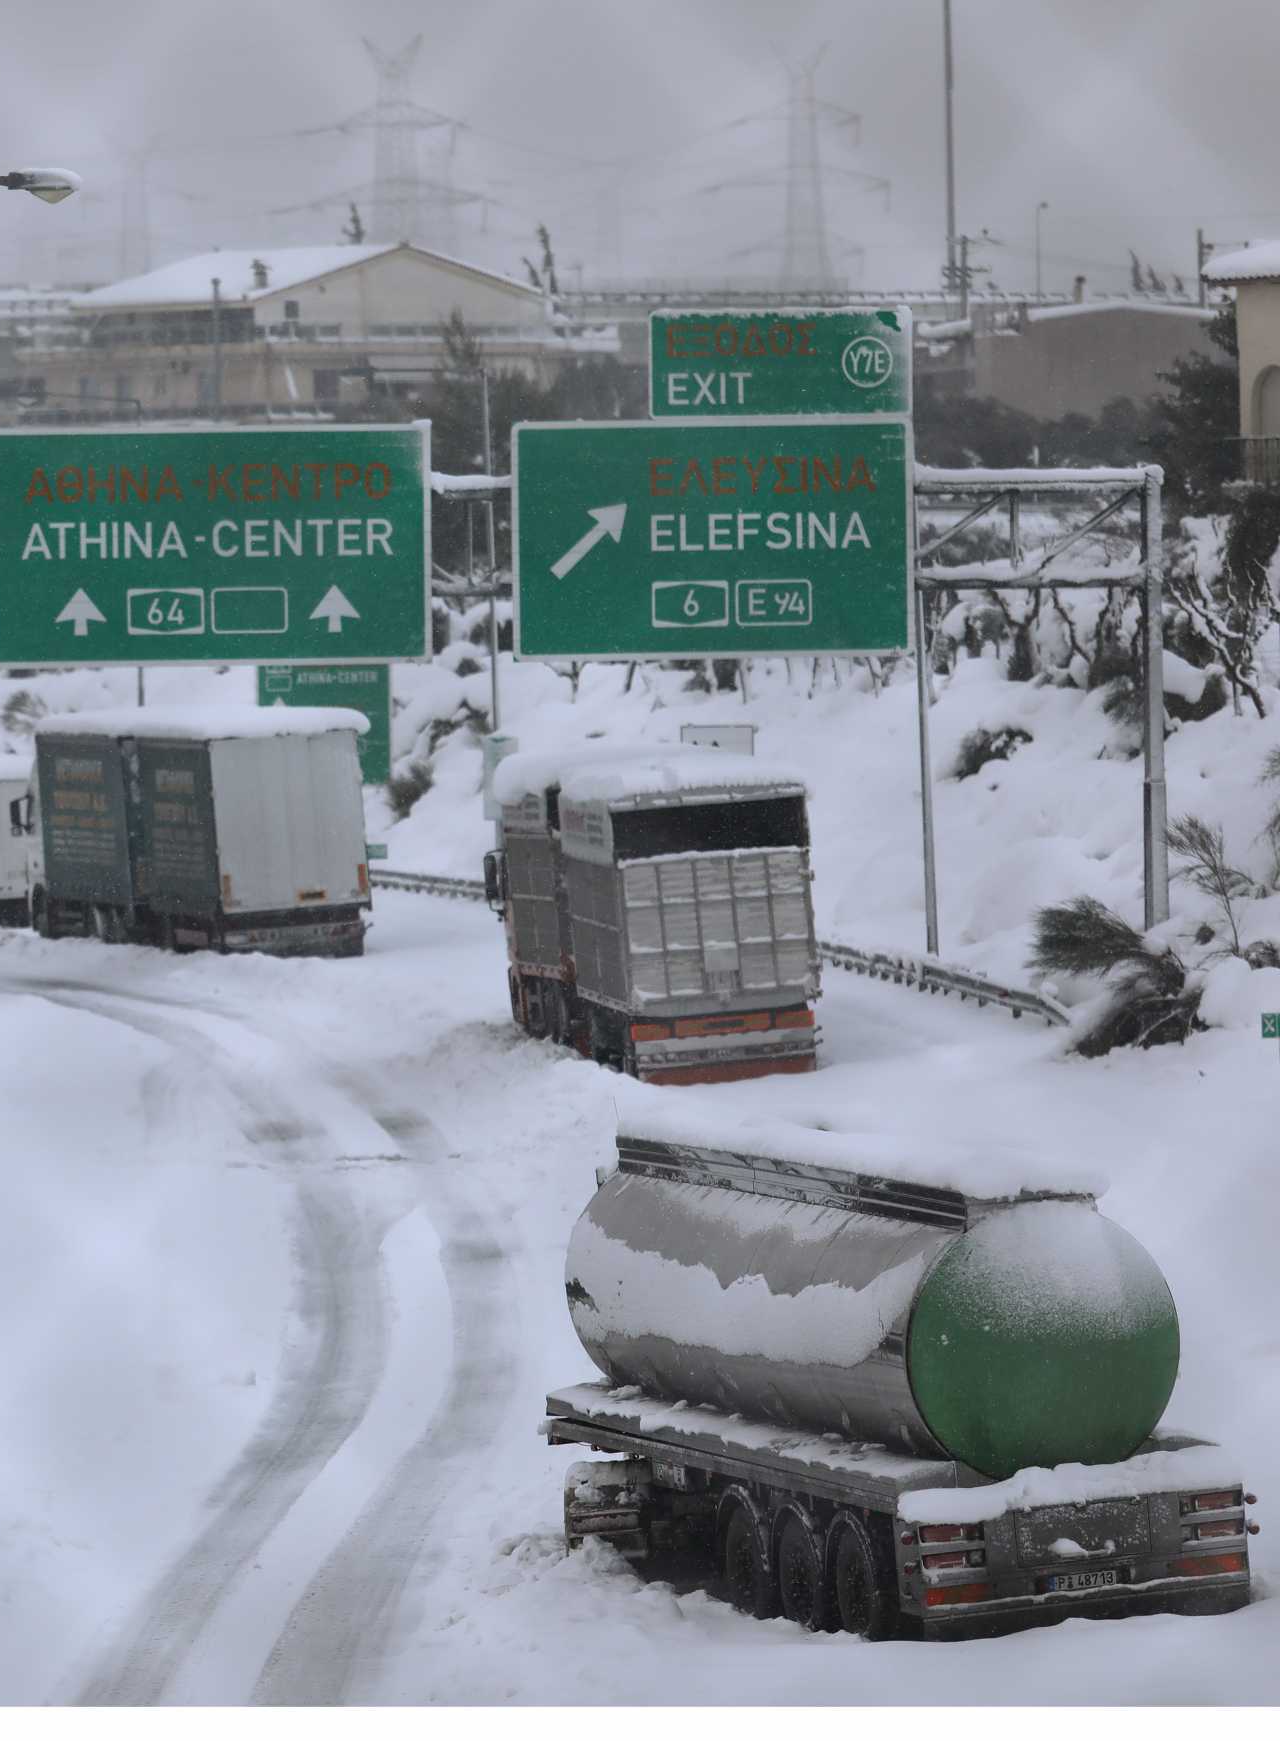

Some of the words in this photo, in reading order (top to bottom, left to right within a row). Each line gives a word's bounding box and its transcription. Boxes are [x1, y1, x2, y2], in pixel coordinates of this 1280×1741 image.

[667, 323, 817, 357] ΕΞΟΔΟΣ
[668, 372, 752, 405] EXIT
[651, 455, 877, 496] ΕΛΕΥΣΙΝΑ
[21, 518, 394, 560] ATHINA-CENTER
[651, 512, 871, 551] ELEFSINA
[147, 598, 186, 625] 64
[683, 590, 700, 617] 6
[748, 589, 767, 616] E
[774, 591, 806, 615] 94
